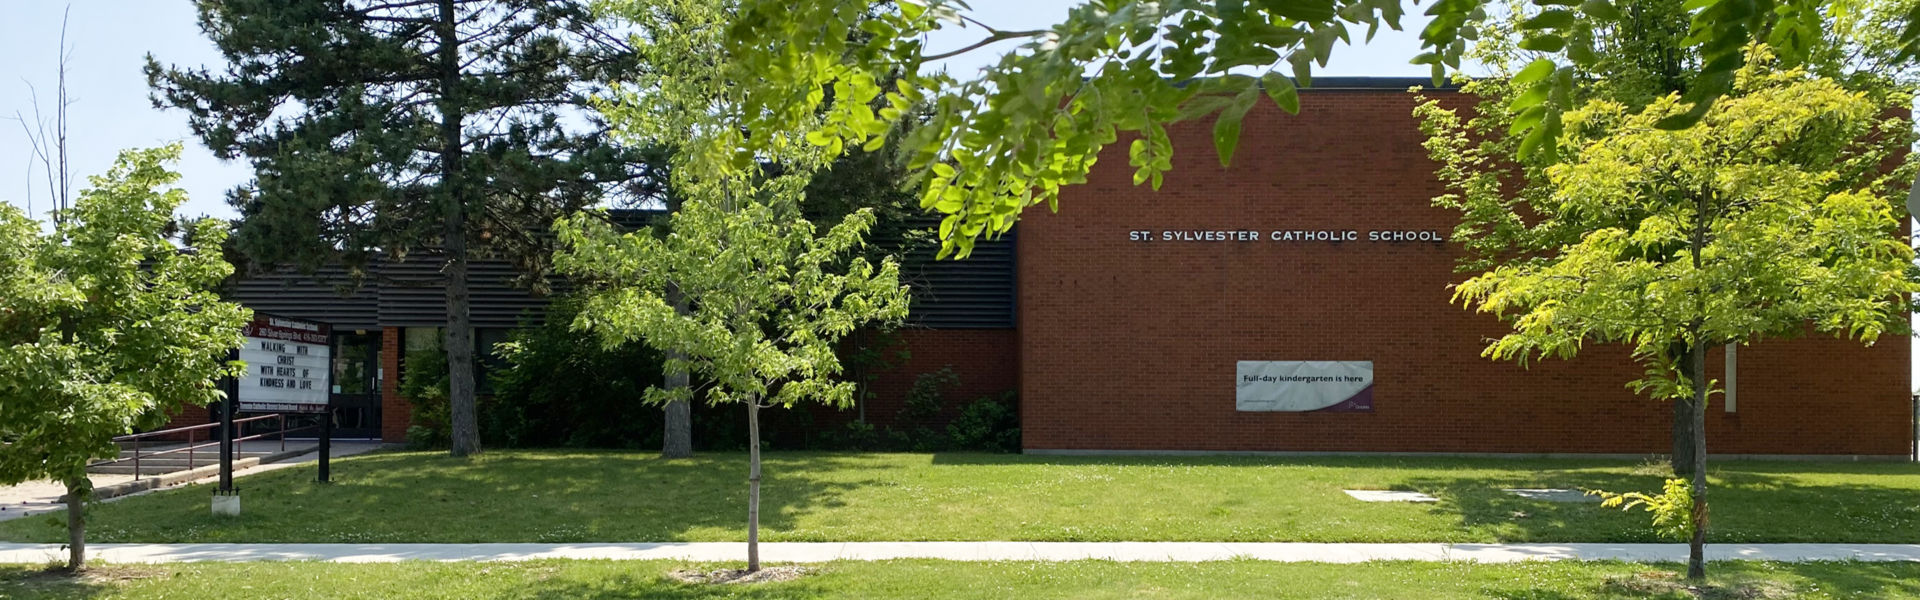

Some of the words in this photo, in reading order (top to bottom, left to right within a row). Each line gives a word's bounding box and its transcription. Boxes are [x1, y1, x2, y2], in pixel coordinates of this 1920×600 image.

[1129, 230, 1154, 242] ST.
[1162, 230, 1260, 242] SYLVESTER
[1270, 230, 1358, 242] CATHOLIC
[1368, 230, 1443, 242] SCHOOL
[261, 342, 285, 353] WALKING
[297, 346, 308, 355] WITH
[277, 356, 294, 365] CHRIST
[260, 366, 273, 375] WITH
[277, 367, 296, 377] HEARTS
[303, 369, 309, 378] OF
[260, 378, 284, 388] KINDNESS
[287, 379, 296, 388] AND
[300, 381, 311, 389] LOVE
[1244, 375, 1277, 383] Full-day
[1280, 375, 1333, 383] kindergarten
